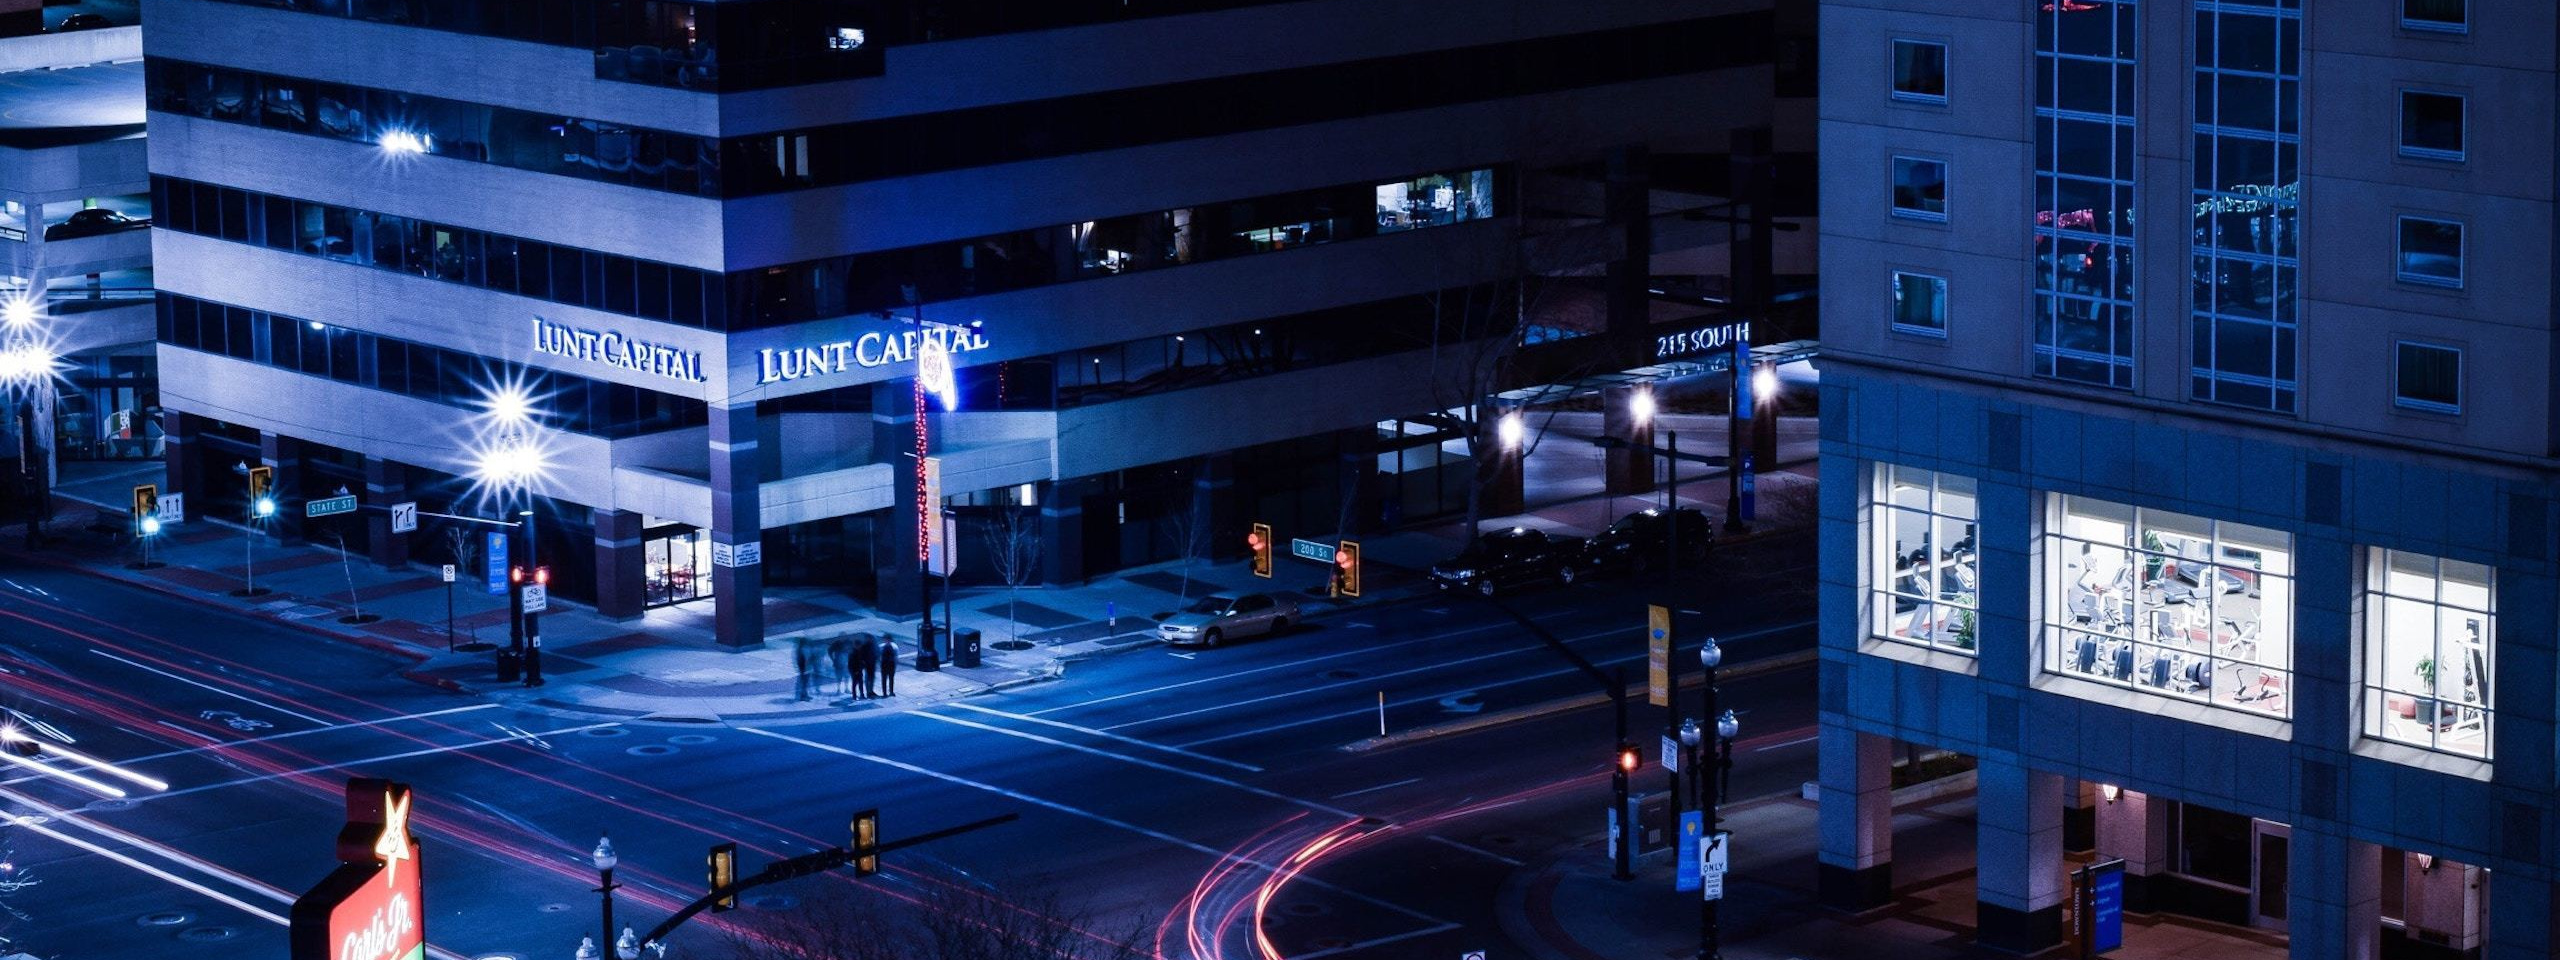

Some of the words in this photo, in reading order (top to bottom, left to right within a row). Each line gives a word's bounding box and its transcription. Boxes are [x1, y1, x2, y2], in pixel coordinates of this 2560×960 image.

[532, 318, 598, 362] LUNT
[599, 332, 704, 383] CAPITAL
[760, 341, 852, 384] LUNT
[854, 326, 989, 368] CAPITAL
[1657, 333, 1686, 357] 215
[1690, 322, 1750, 352] SOUTH
[311, 502, 337, 514] STATE
[341, 499, 353, 509] ST
[1300, 543, 1315, 555] 200
[1703, 862, 1724, 873] ONLY
[386, 892, 413, 952] Jr.
